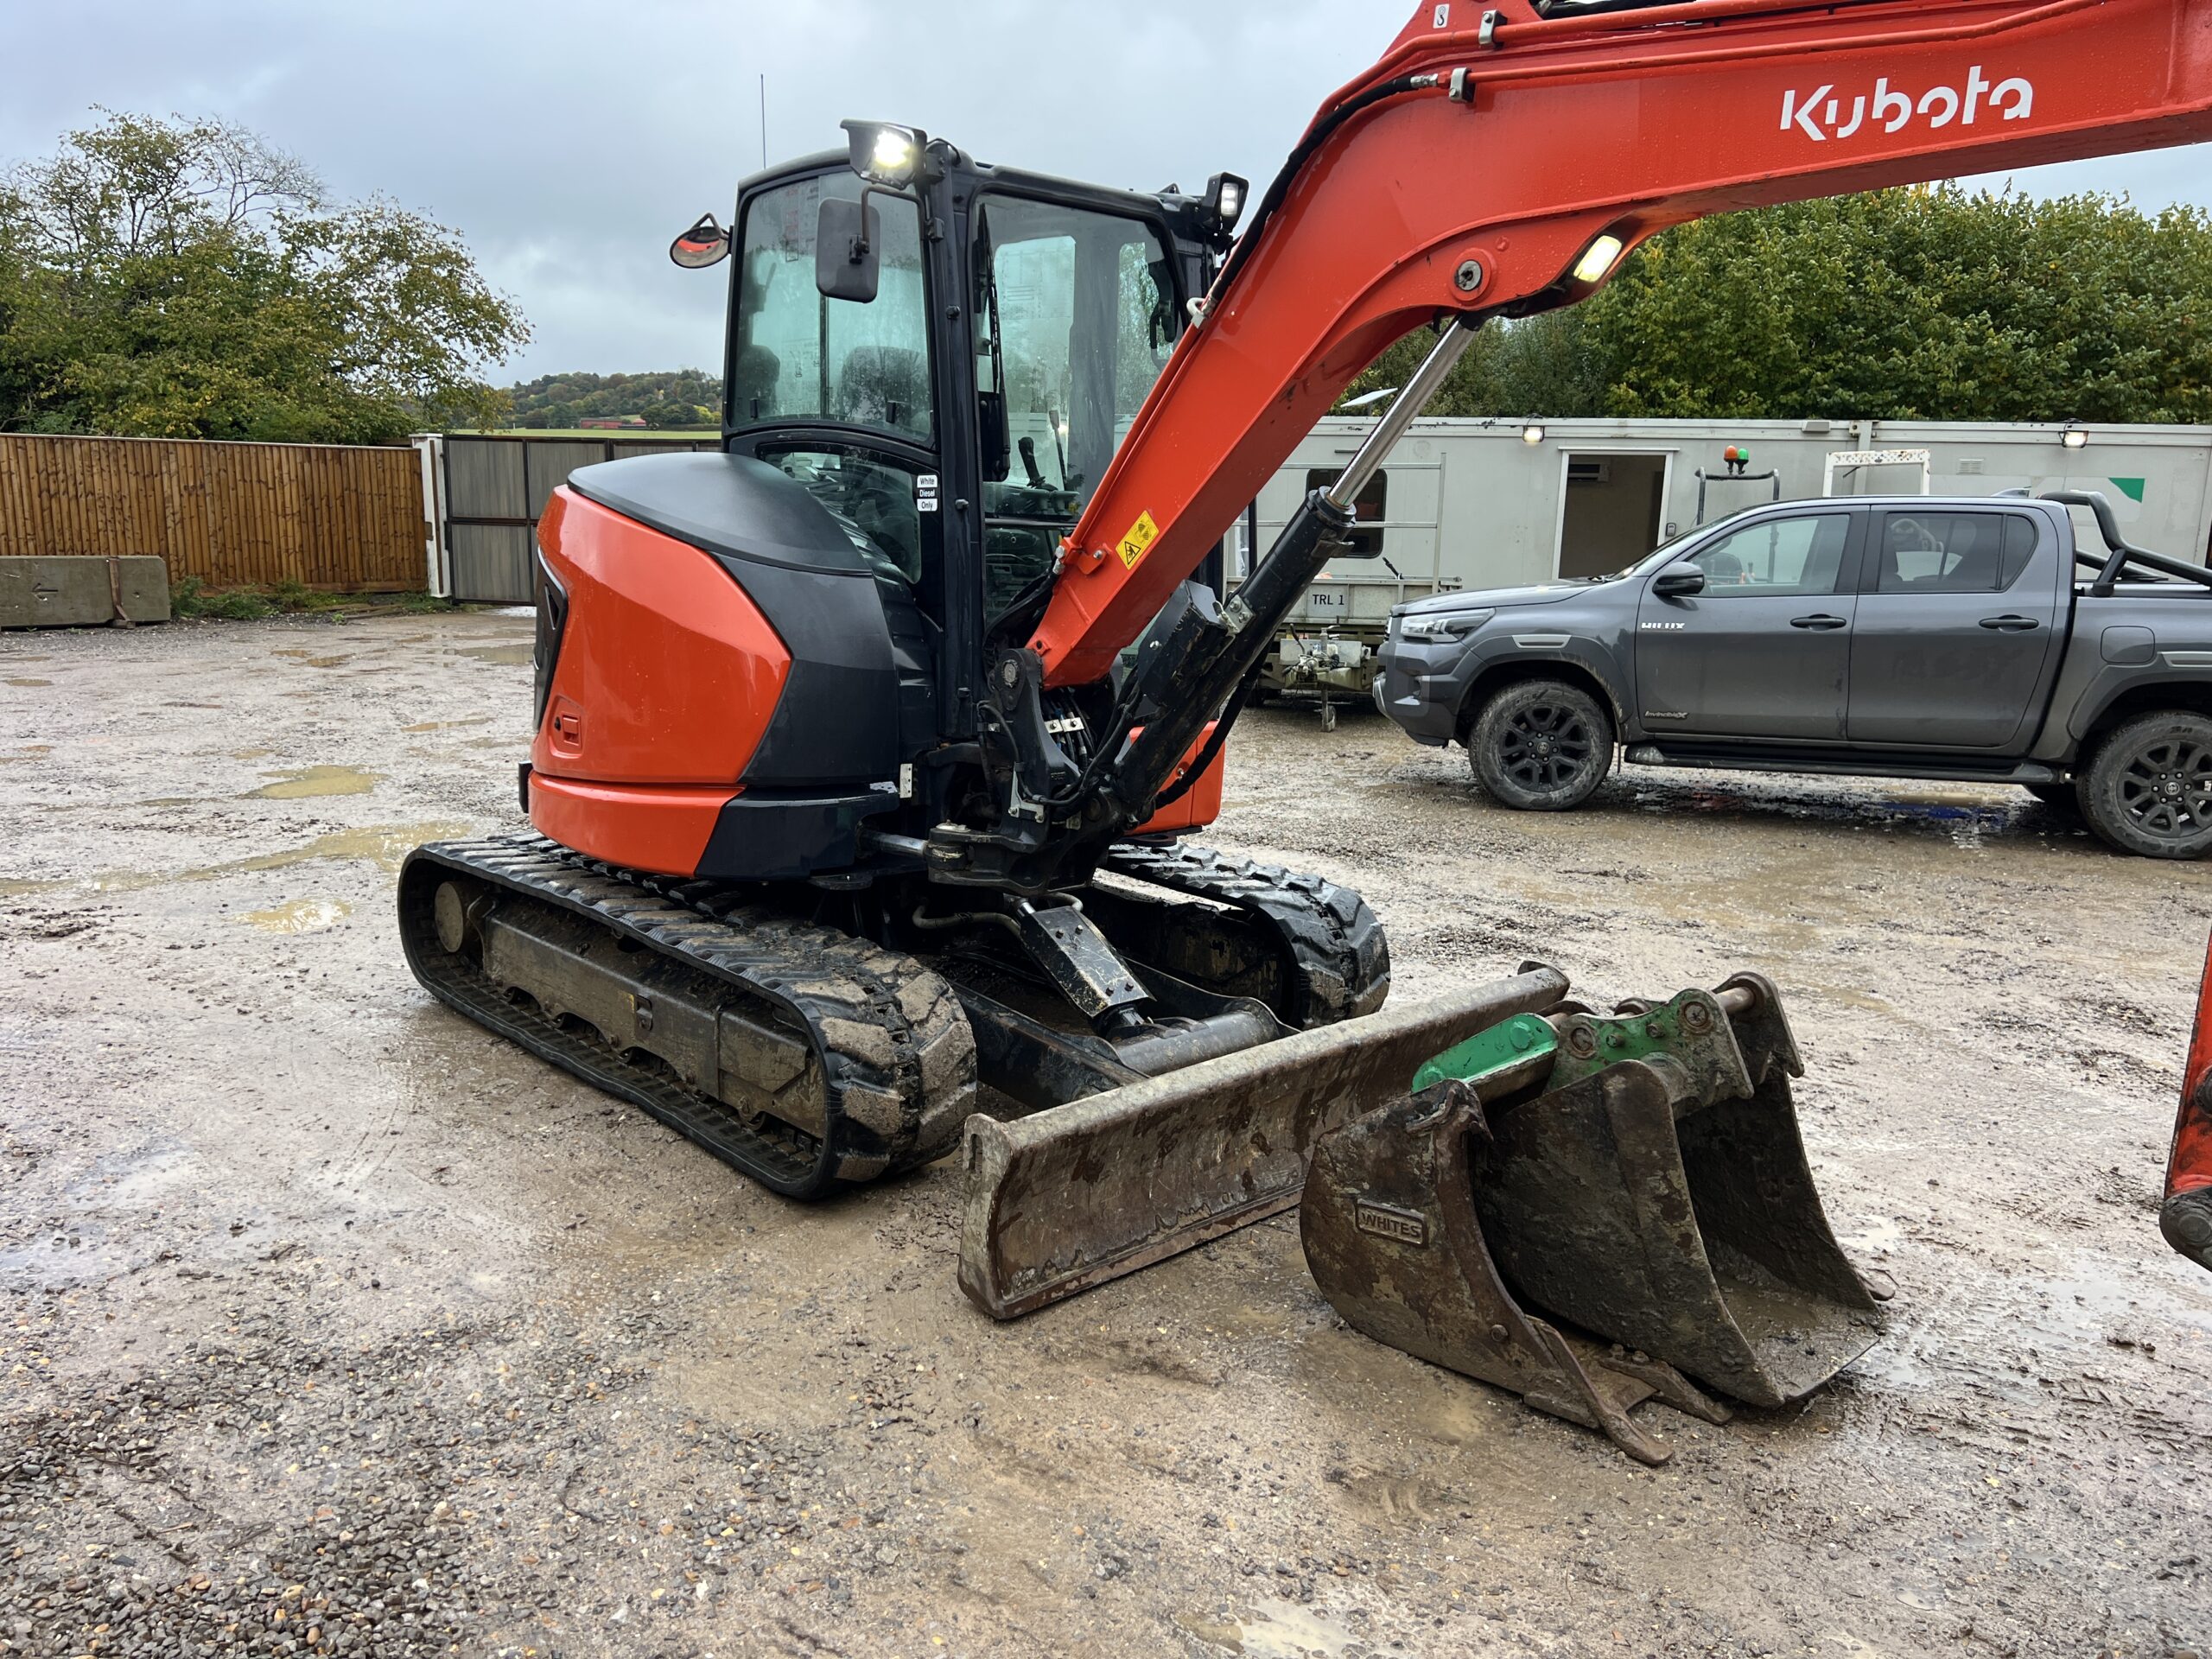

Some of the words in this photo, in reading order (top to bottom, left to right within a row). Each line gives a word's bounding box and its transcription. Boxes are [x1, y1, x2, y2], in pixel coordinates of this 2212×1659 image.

[1780, 65, 2033, 141] Kubota
[919, 489, 935, 498] Diesel
[921, 501, 933, 511] Only
[1313, 594, 1333, 605] TRL
[1338, 594, 1344, 605] 1
[1361, 1211, 1421, 1238] WHITES
